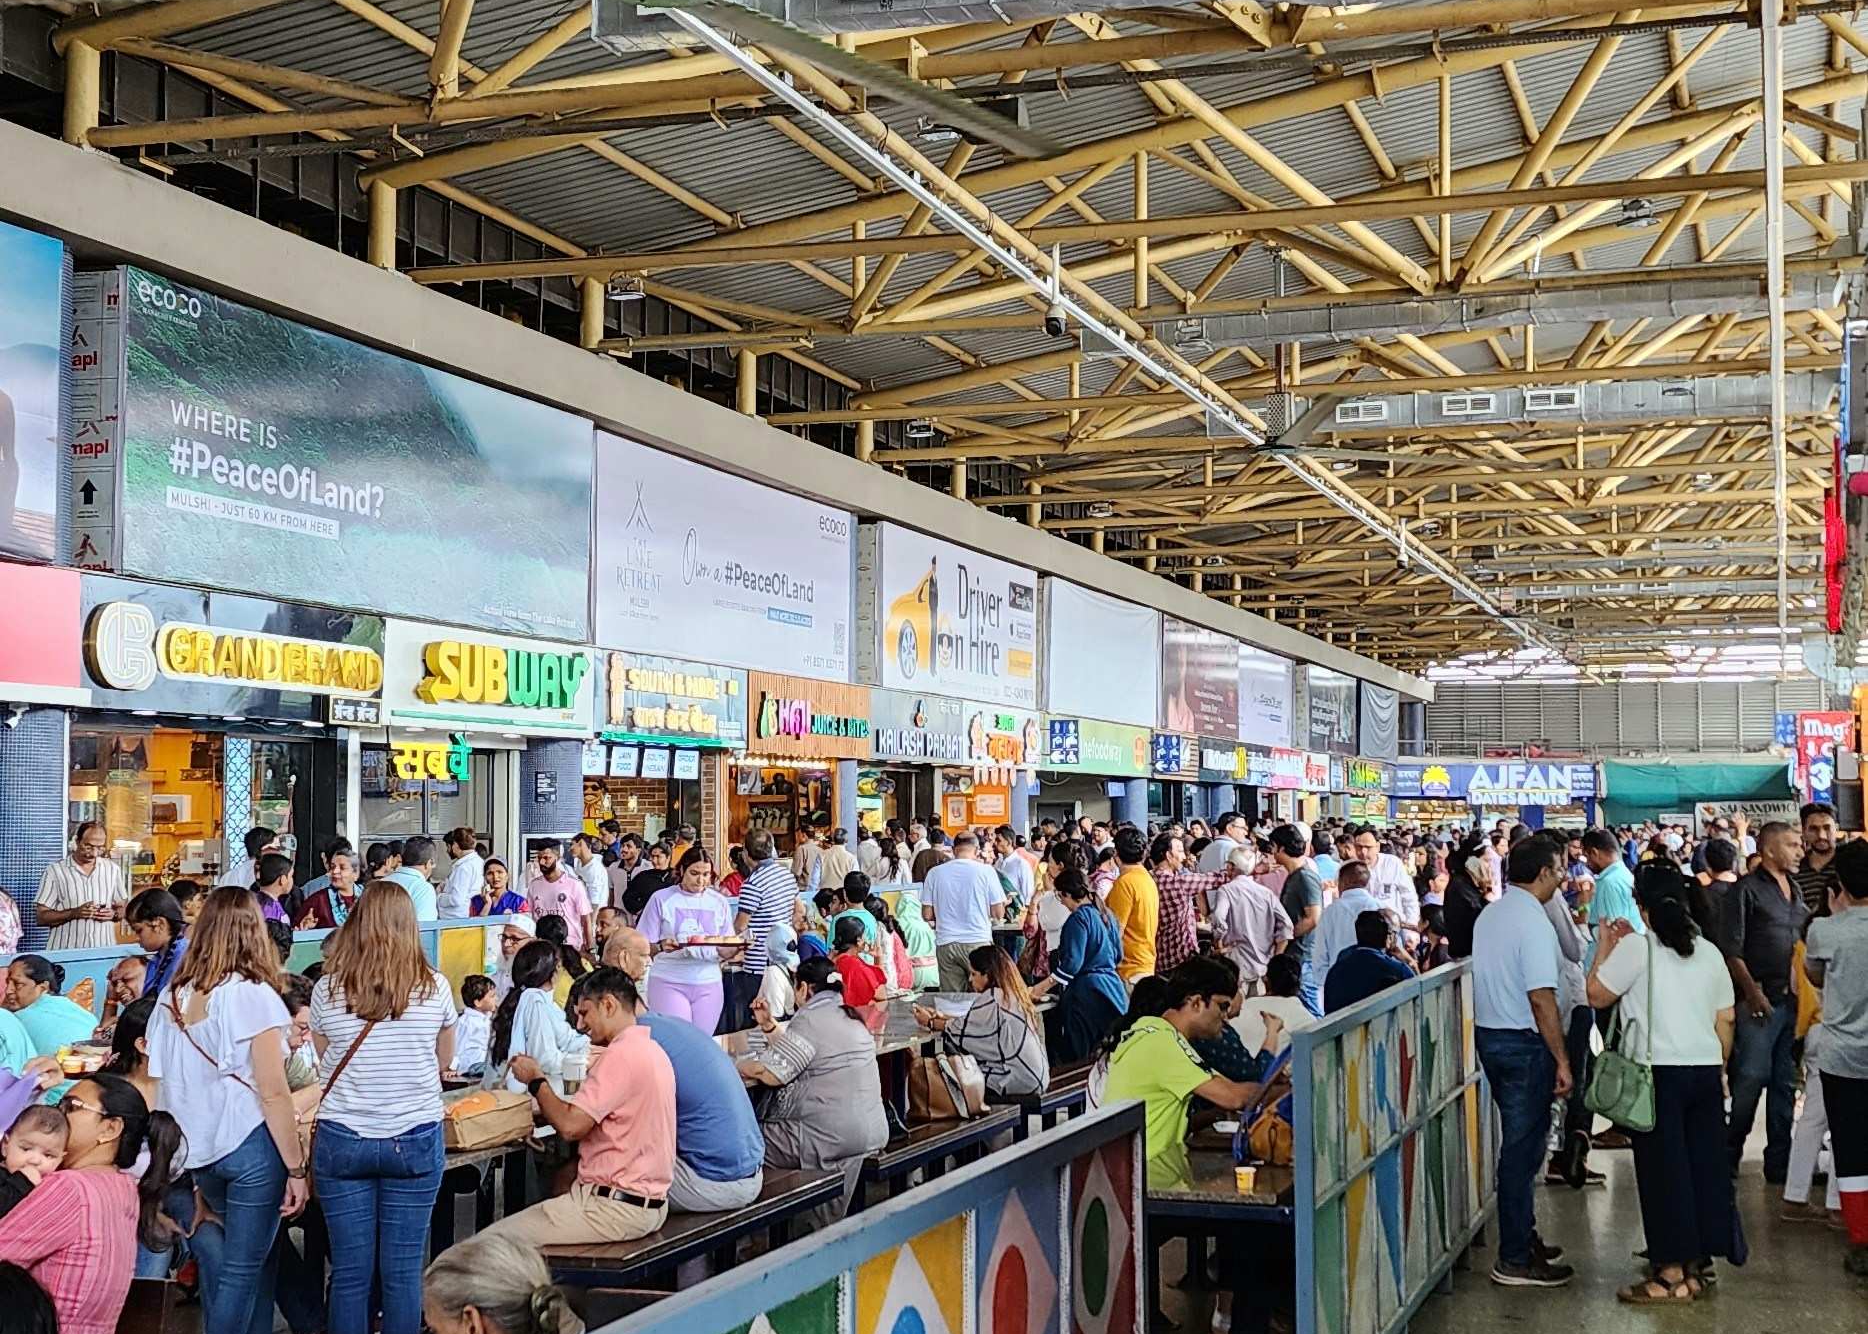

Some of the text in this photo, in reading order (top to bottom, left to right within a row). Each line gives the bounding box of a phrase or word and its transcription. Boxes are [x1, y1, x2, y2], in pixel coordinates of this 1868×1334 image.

[138, 281, 202, 318] ecoco
[170, 399, 278, 449] WHERE IS
[169, 436, 385, 518] #PeaceOfLand?
[171, 491, 211, 511] MULSHI
[220, 502, 245, 517] JUST
[248, 508, 260, 520] 60
[264, 511, 278, 524] KM
[280, 514, 307, 529] FROM
[310, 522, 334, 535] HERE
[819, 515, 847, 537] ecoco
[626, 546, 653, 569] LAKE
[616, 566, 663, 593] RETREAT
[725, 560, 814, 604] #PeaceOfLand
[957, 563, 1002, 629] Driver
[416, 640, 591, 710] SUBWAY
[628, 668, 720, 699] SOUTH & MORE
[390, 731, 473, 782] सबवे
[879, 728, 925, 757] KAILASH
[926, 731, 963, 760] PARBAT
[1468, 764, 1573, 790] AJFAN
[1720, 803, 1738, 813] SAI
